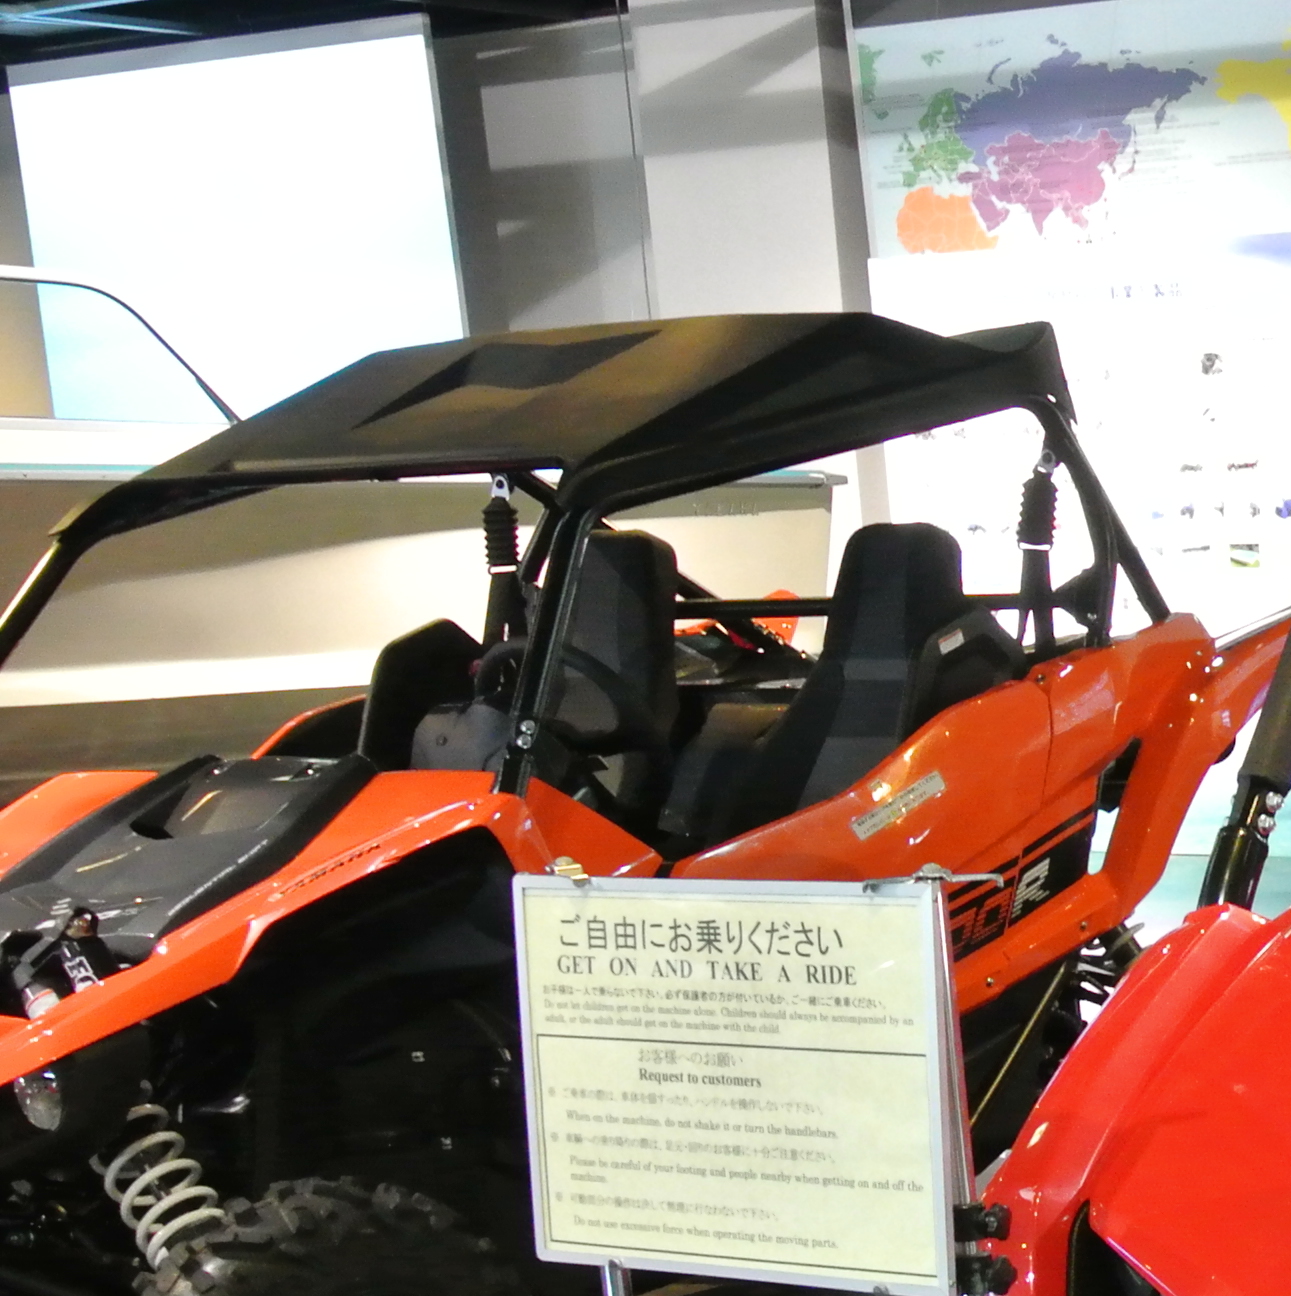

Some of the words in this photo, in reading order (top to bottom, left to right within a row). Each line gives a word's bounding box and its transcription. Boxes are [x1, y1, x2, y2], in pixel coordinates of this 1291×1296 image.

[559, 914, 844, 957] ご自由にお乗りください
[557, 955, 596, 975] GET
[610, 957, 637, 976] ON
[651, 959, 693, 978] AND
[706, 960, 763, 982] TAKE
[777, 964, 791, 983] A
[806, 964, 857, 985] RIDE
[642, 1004, 655, 1014] the
[720, 1008, 757, 1018] Children
[759, 1010, 786, 1020] should
[820, 1013, 828, 1022] be
[889, 1016, 899, 1026] by
[903, 1018, 914, 1026] an
[744, 1024, 756, 1032] the
[638, 1048, 743, 1067] お客様へのお願い
[638, 1068, 684, 1085] Request
[687, 1072, 699, 1083] to
[701, 1072, 762, 1088] customers
[566, 1109, 590, 1122] When
[606, 1114, 619, 1124] the
[665, 1117, 675, 1127] do
[678, 1119, 691, 1128] not
[694, 1120, 720, 1131] shake
[745, 1124, 764, 1134] turn
[767, 1124, 782, 1134] the
[599, 1159, 608, 1168] be
[643, 1161, 652, 1171] of
[654, 1165, 673, 1174] your
[710, 1168, 726, 1178] and
[729, 1170, 757, 1181] people
[761, 1171, 791, 1183] nearby
[795, 1174, 819, 1185] when
[822, 1175, 855, 1188] getting
[858, 1180, 869, 1188] on
[872, 1180, 889, 1190] and
[892, 1180, 905, 1191] off
[908, 1181, 924, 1192] the
[574, 1214, 585, 1226] Do
[588, 1217, 601, 1227] not
[686, 1226, 710, 1237] when
[712, 1228, 756, 1242] operating
[758, 1232, 774, 1243] the
[776, 1235, 808, 1247] moving
